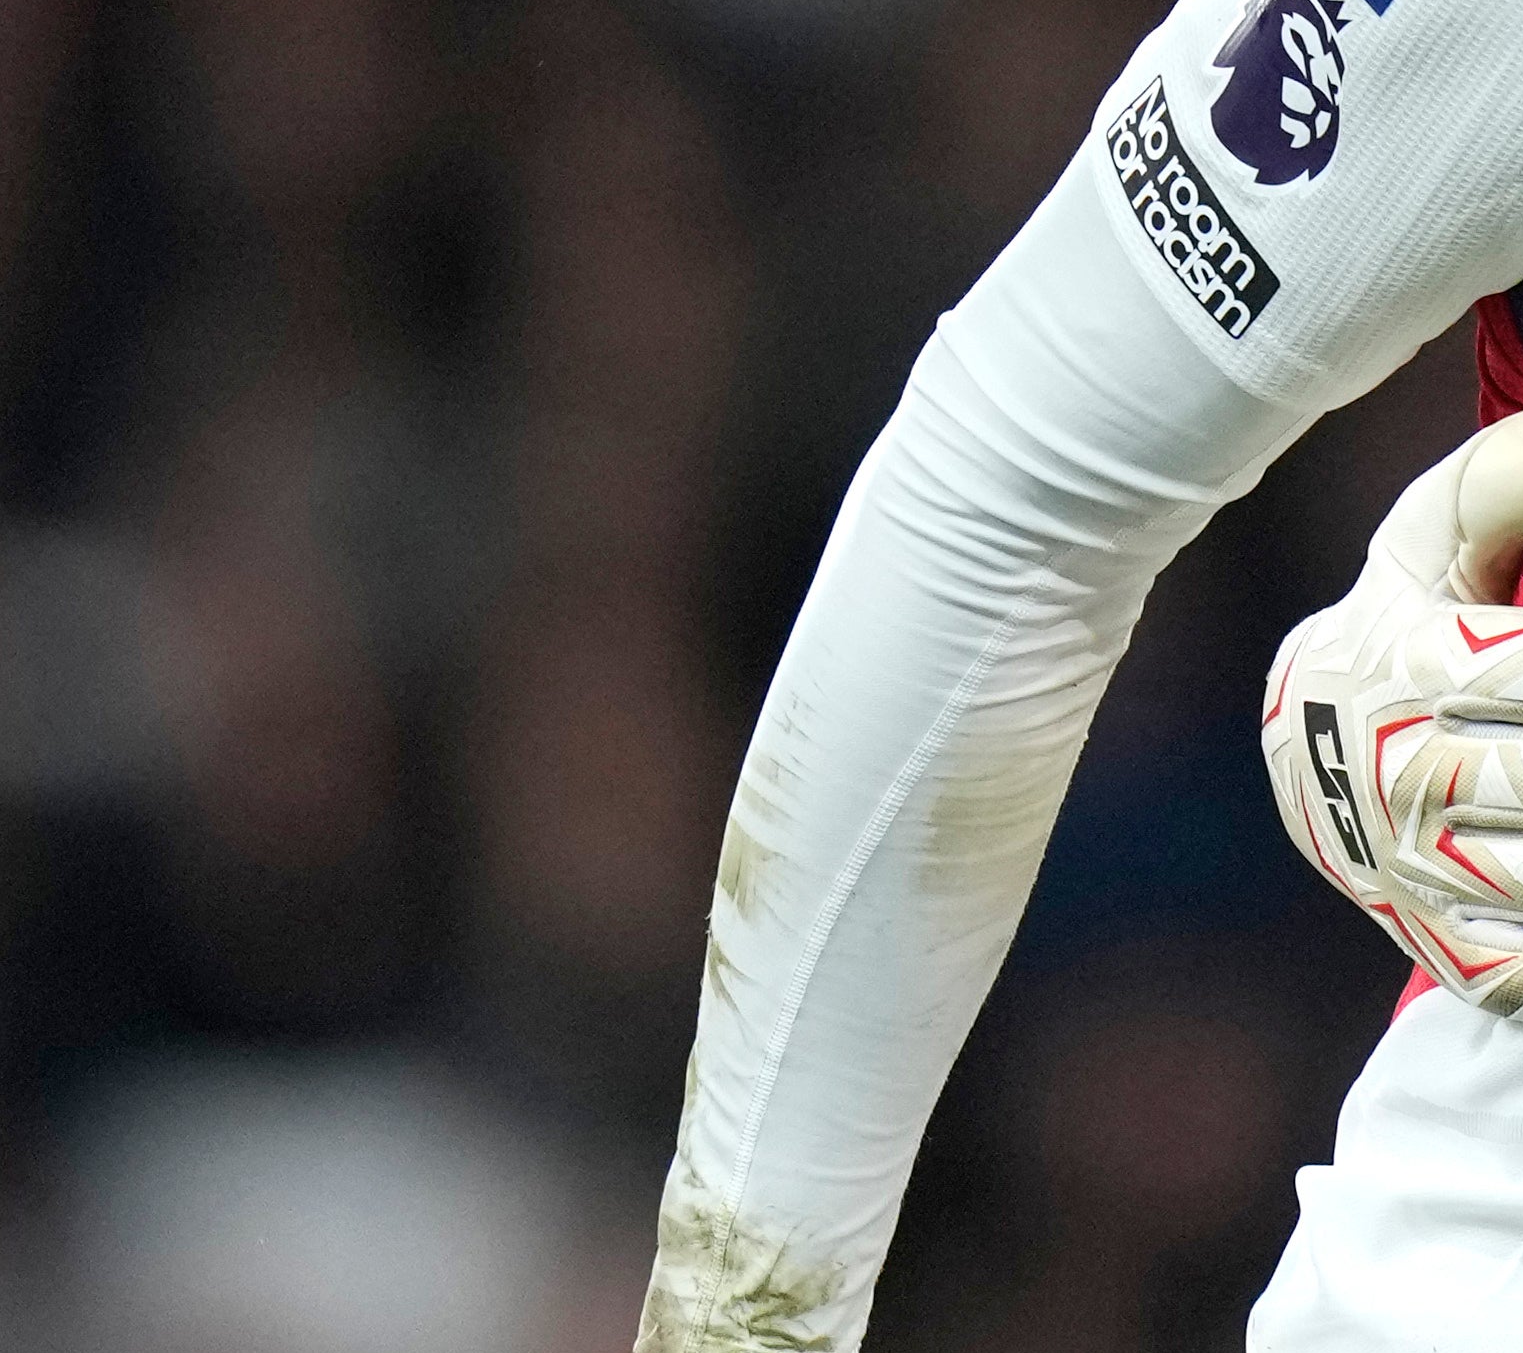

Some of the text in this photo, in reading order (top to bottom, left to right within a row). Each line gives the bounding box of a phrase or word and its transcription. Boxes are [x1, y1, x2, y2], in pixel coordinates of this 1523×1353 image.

[1108, 112, 1252, 338] for racism
[1131, 77, 1257, 292] No room
